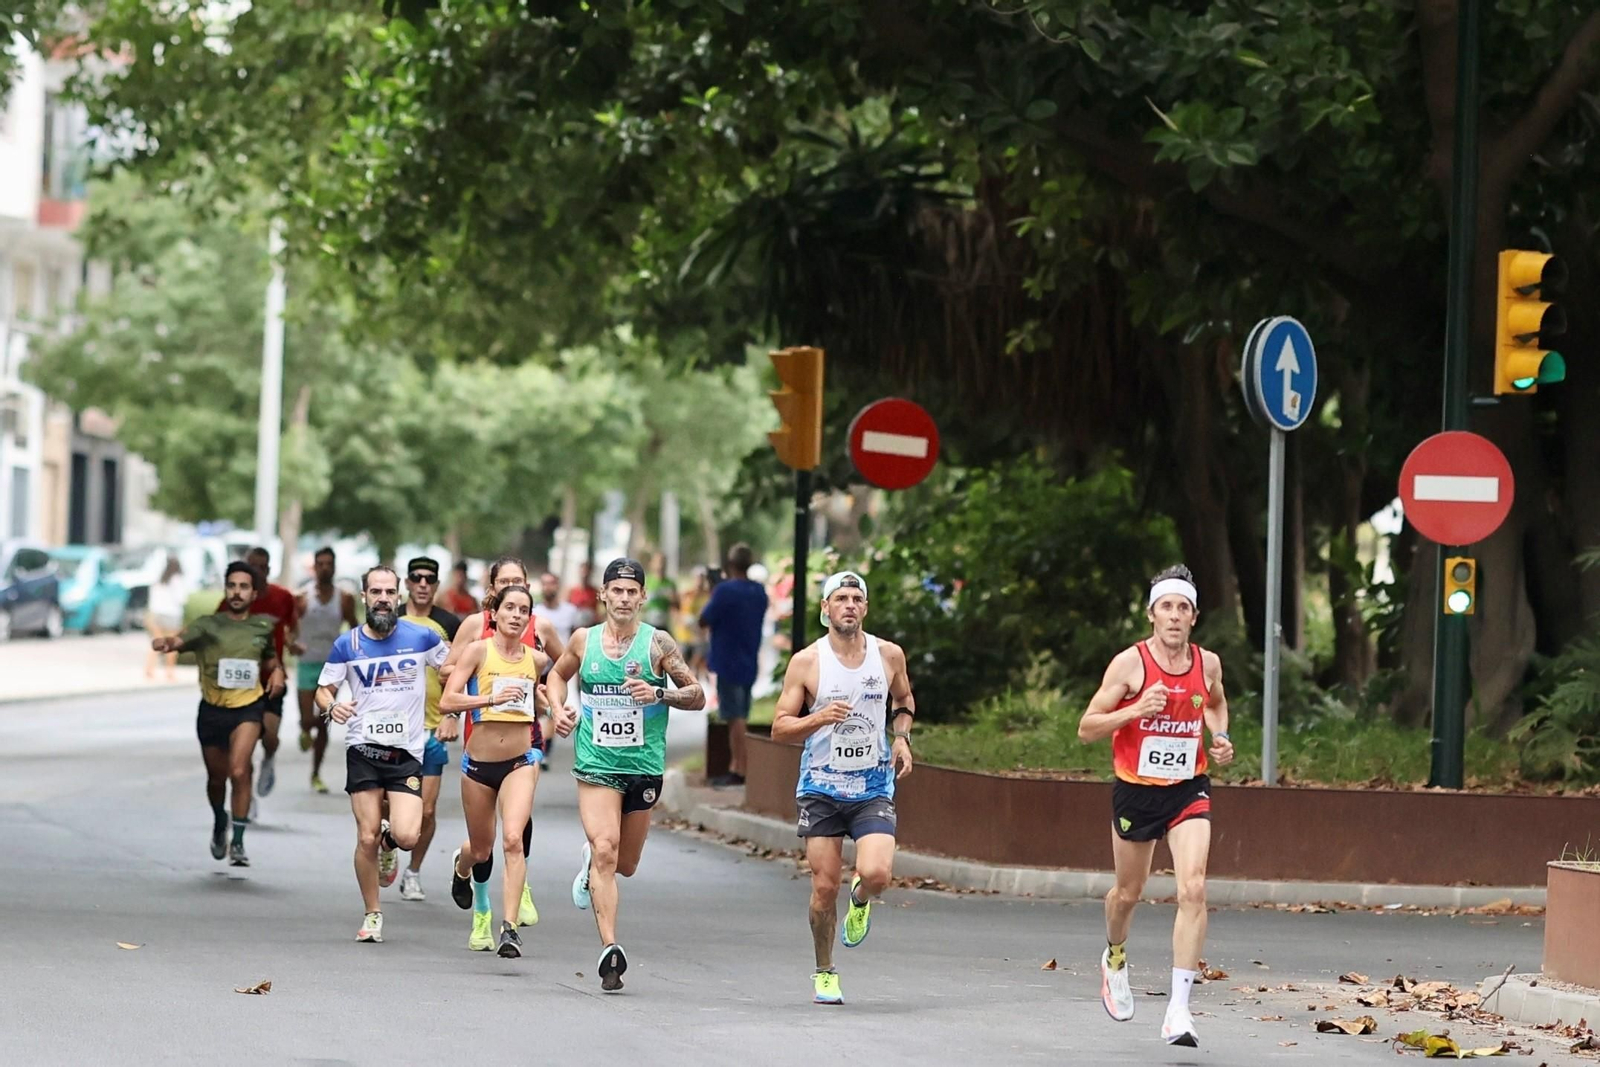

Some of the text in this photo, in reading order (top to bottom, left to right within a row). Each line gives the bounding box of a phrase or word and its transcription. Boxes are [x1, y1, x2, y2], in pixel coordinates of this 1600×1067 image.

[224, 669, 252, 680] 596
[352, 658, 418, 688] VAS
[366, 723, 404, 734] 1200
[600, 722, 635, 736] 403
[835, 744, 872, 758] 1067
[1148, 750, 1187, 767] 624
